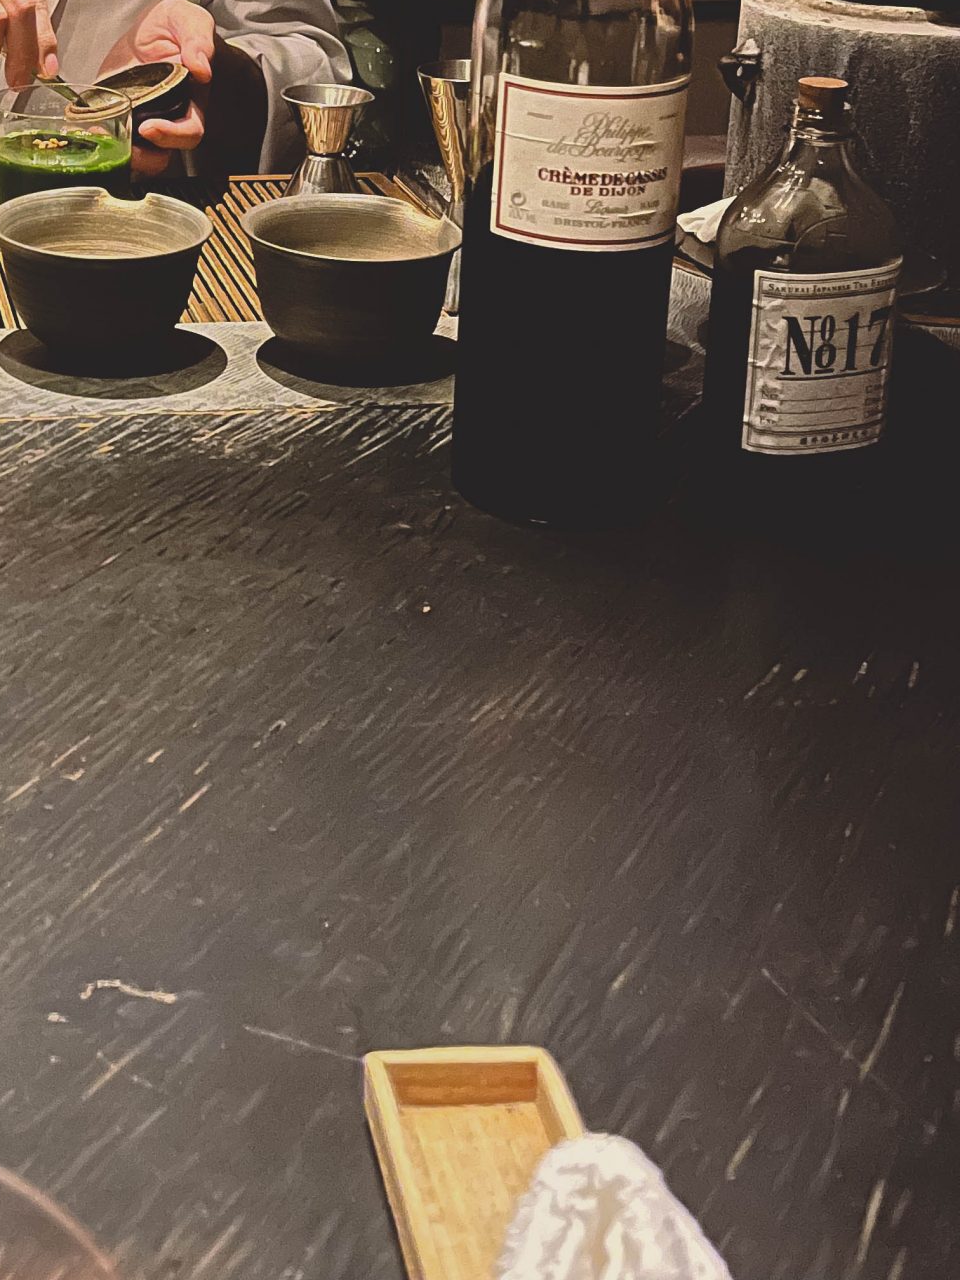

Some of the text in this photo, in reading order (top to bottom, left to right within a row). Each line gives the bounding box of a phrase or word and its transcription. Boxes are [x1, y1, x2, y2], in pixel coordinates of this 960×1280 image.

[570, 184, 647, 197] DE DIJON
[768, 283, 810, 293] SAKURAI
[813, 283, 851, 294] JAPANESE
